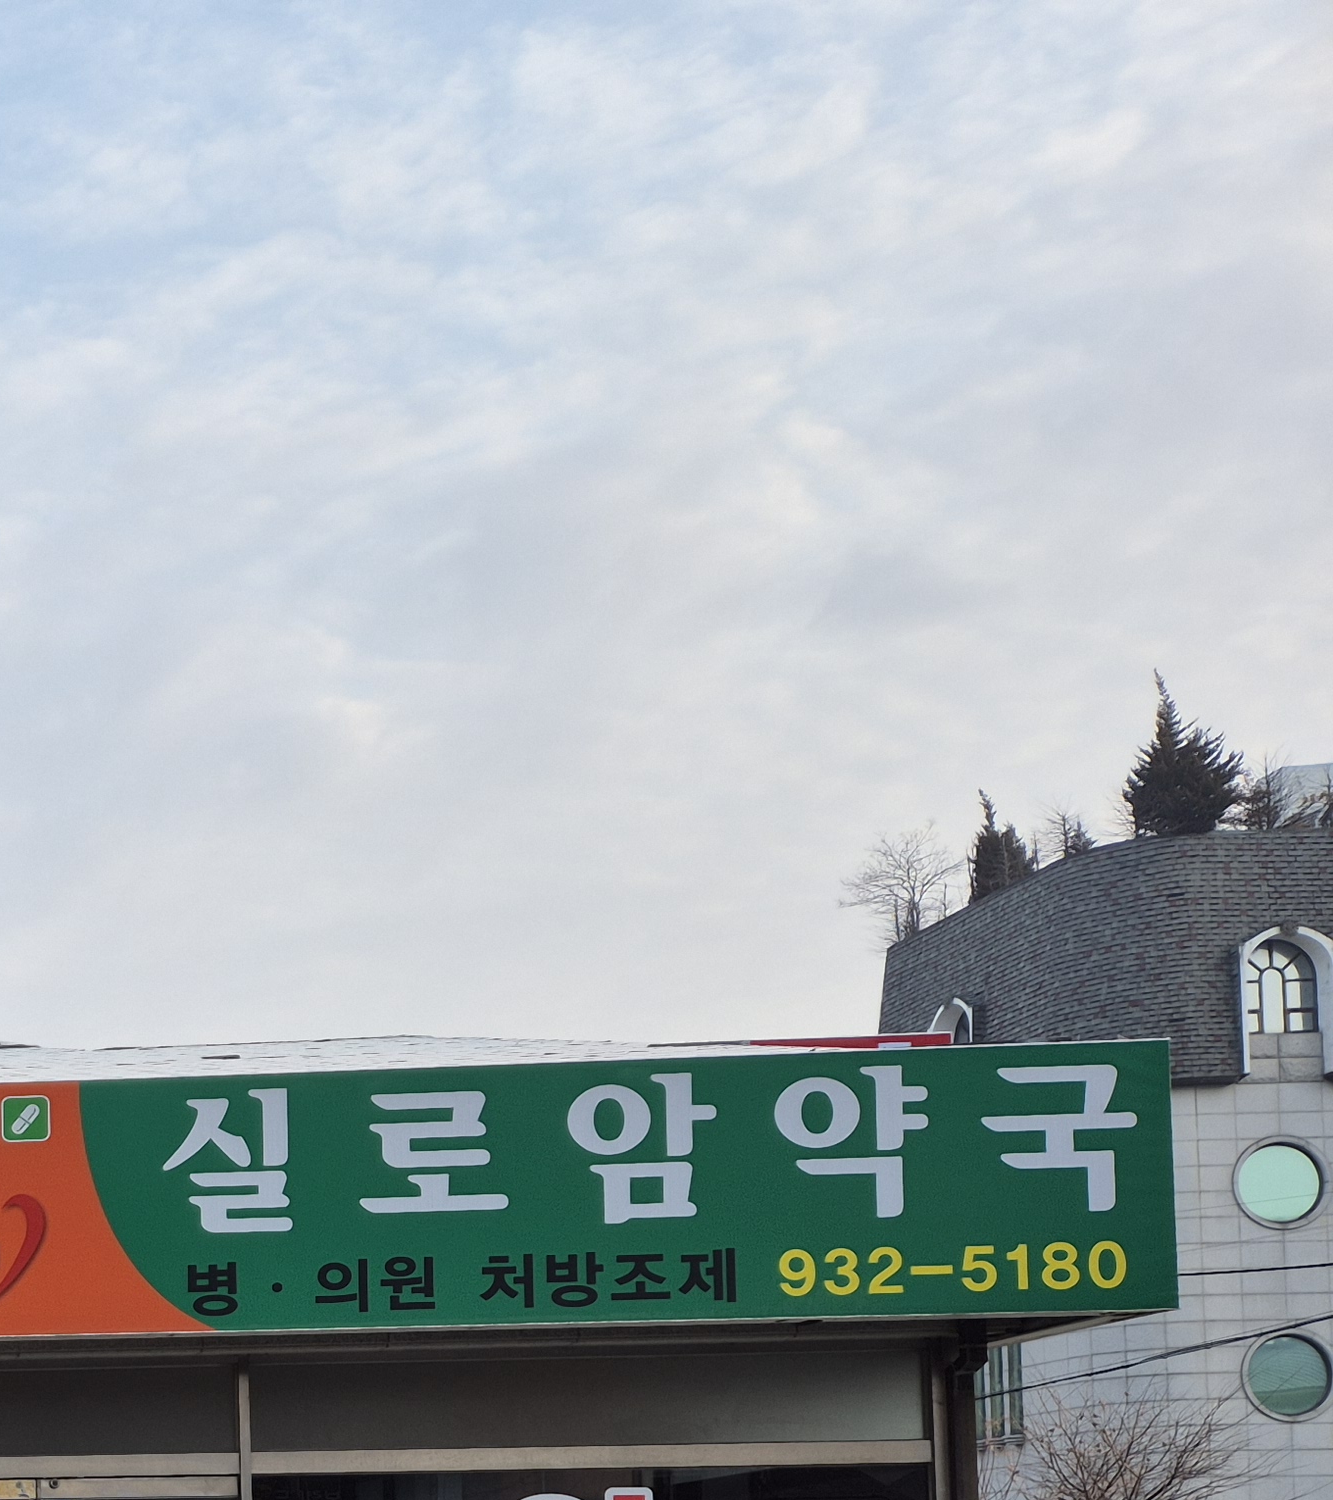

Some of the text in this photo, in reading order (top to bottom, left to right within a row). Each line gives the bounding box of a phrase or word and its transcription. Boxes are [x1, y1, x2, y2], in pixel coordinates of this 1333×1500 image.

[161, 1064, 1139, 1234] 실로암약국
[479, 1248, 738, 1309] 처방조제
[779, 1241, 1127, 1297] 932-5180
